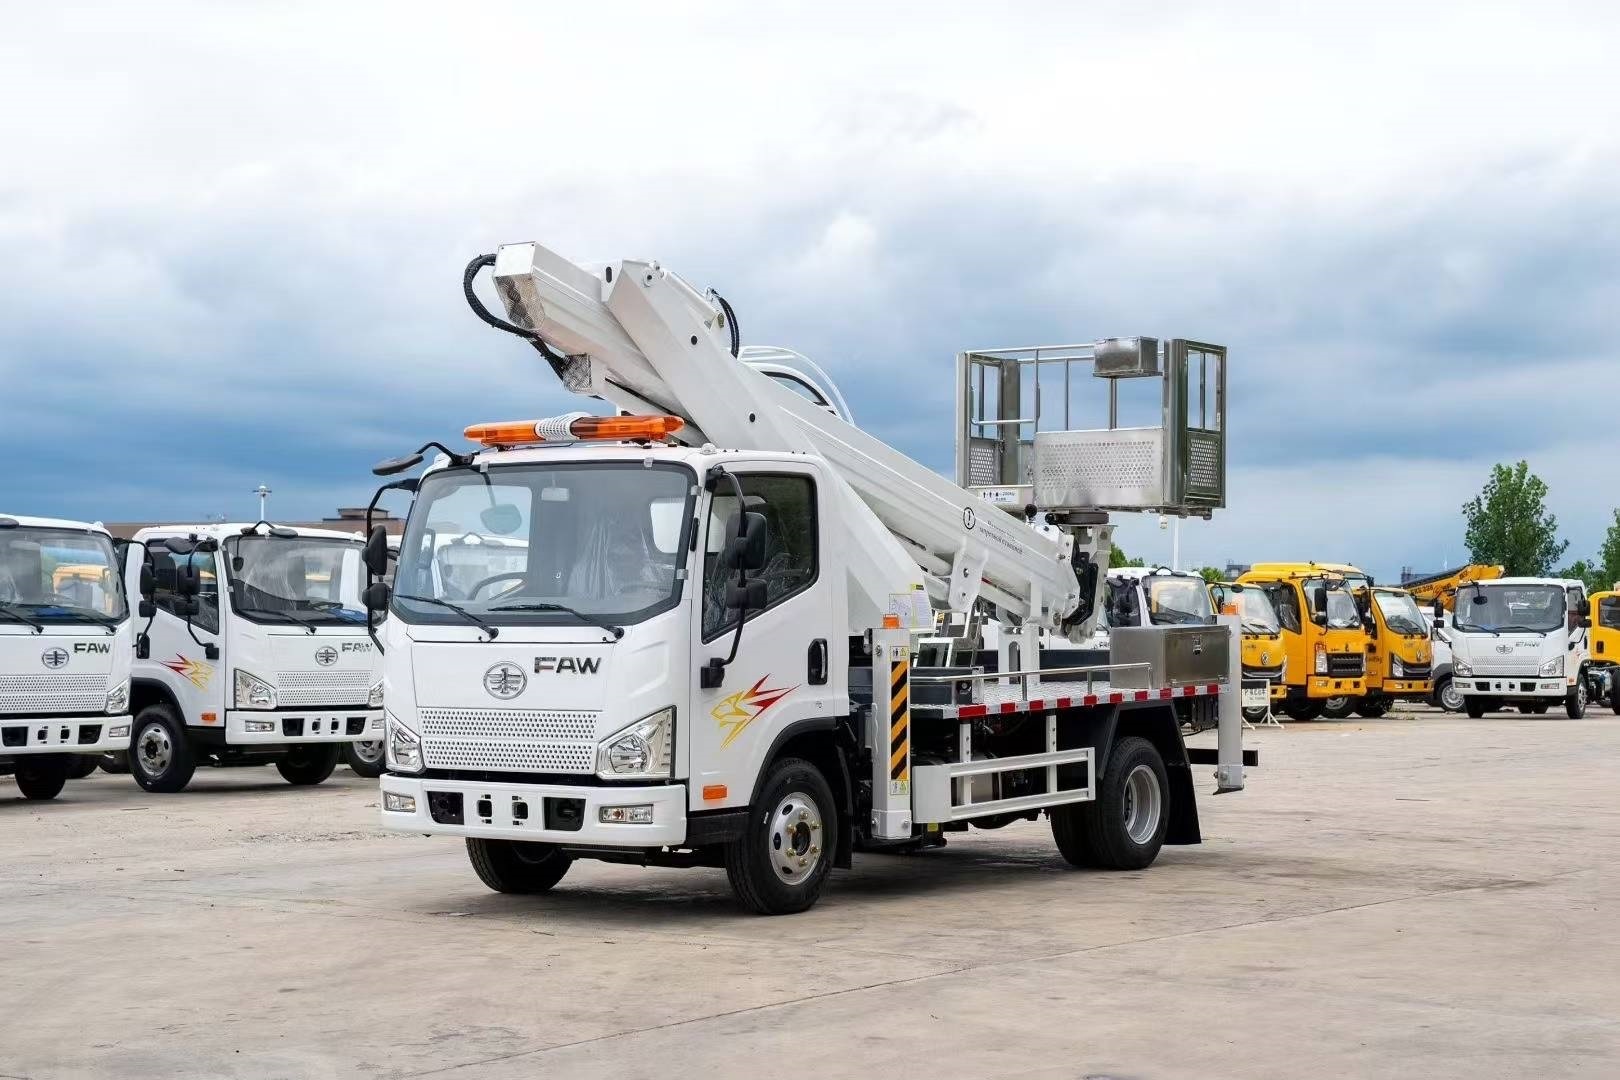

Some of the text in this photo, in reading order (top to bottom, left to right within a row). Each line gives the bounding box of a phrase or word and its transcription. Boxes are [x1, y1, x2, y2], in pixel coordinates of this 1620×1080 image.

[74, 643, 111, 653] FAW
[341, 642, 373, 652] FAW
[534, 656, 602, 674] FAW
